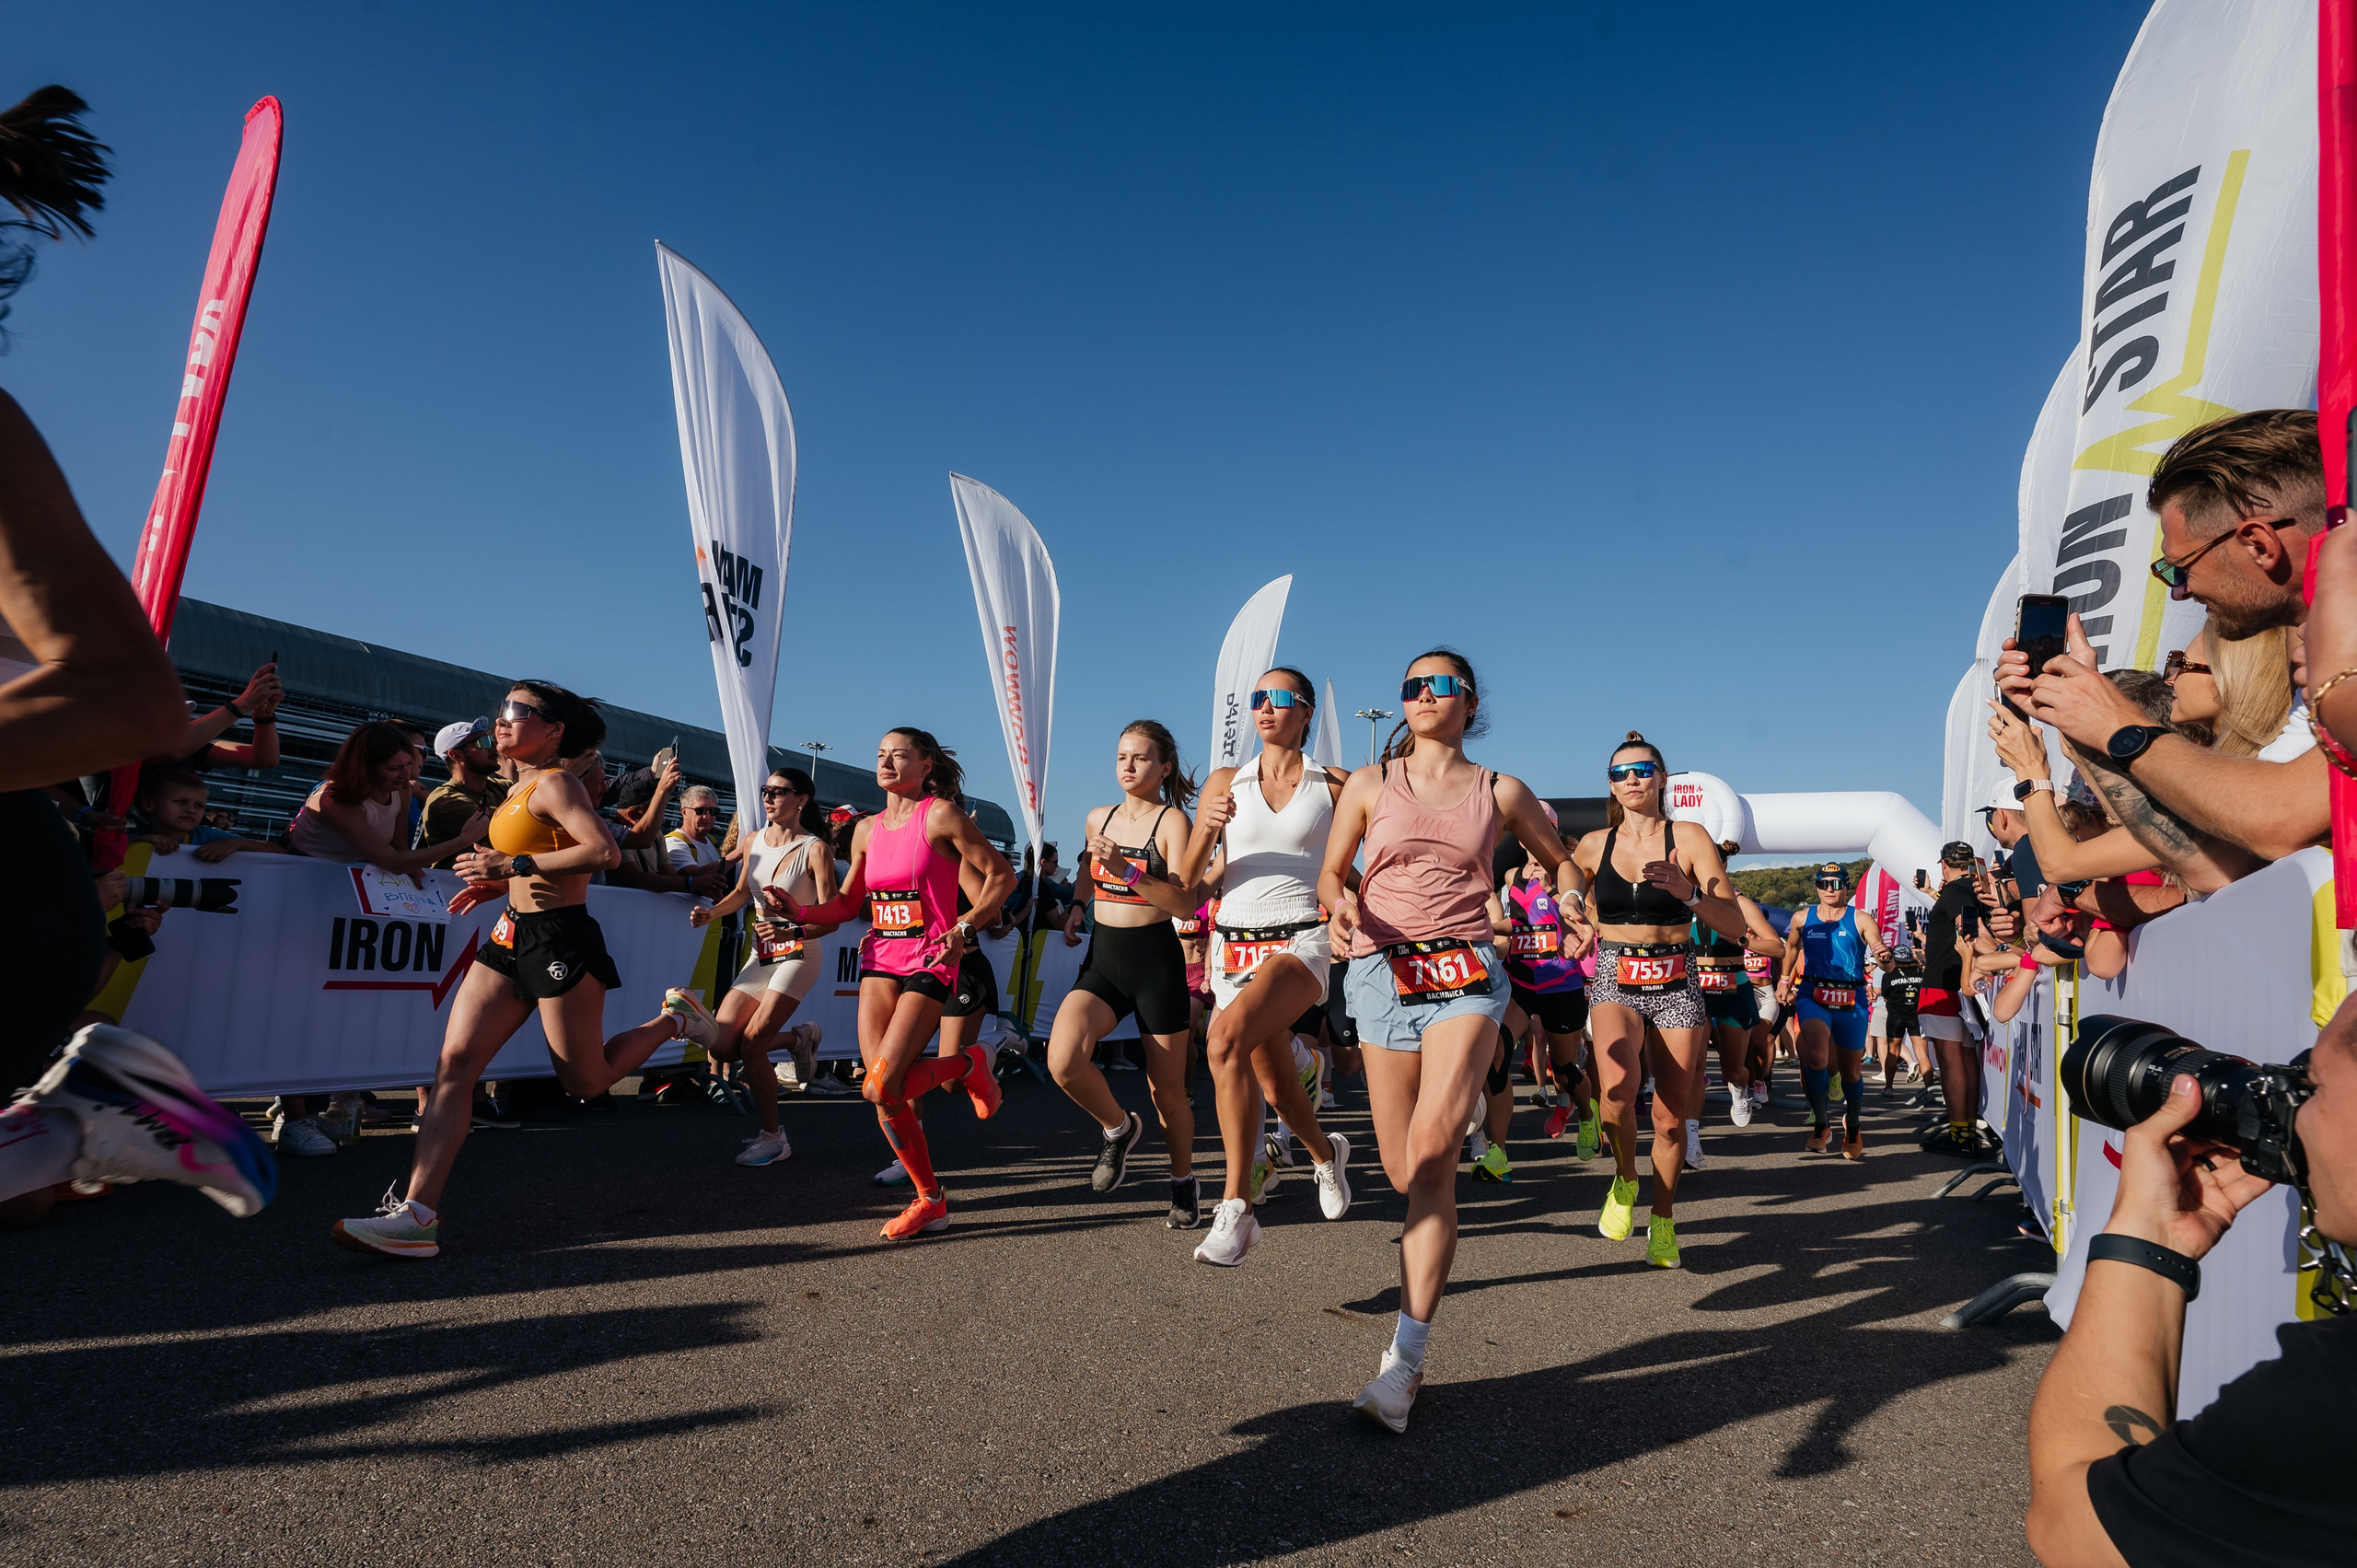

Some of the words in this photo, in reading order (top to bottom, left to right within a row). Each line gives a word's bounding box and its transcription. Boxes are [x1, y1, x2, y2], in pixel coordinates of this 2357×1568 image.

[2082, 165, 2201, 417] STAR
[2053, 493, 2133, 665] ON
[1674, 784, 1695, 794] IRON
[1673, 795, 1703, 807] LADY
[1406, 815, 1460, 842] NIKE
[1884, 889, 1899, 920] LADY
[876, 905, 911, 924] 7413
[329, 917, 446, 972] IRON
[1517, 935, 1547, 949] 7231
[1409, 953, 1470, 985] 7161
[1629, 959, 1674, 981] 7557
[1743, 958, 1762, 968] 7572
[1699, 974, 1728, 987] 7715
[1426, 989, 1465, 1000] ВАСИЛИСА
[1822, 990, 1848, 1004] 7111
